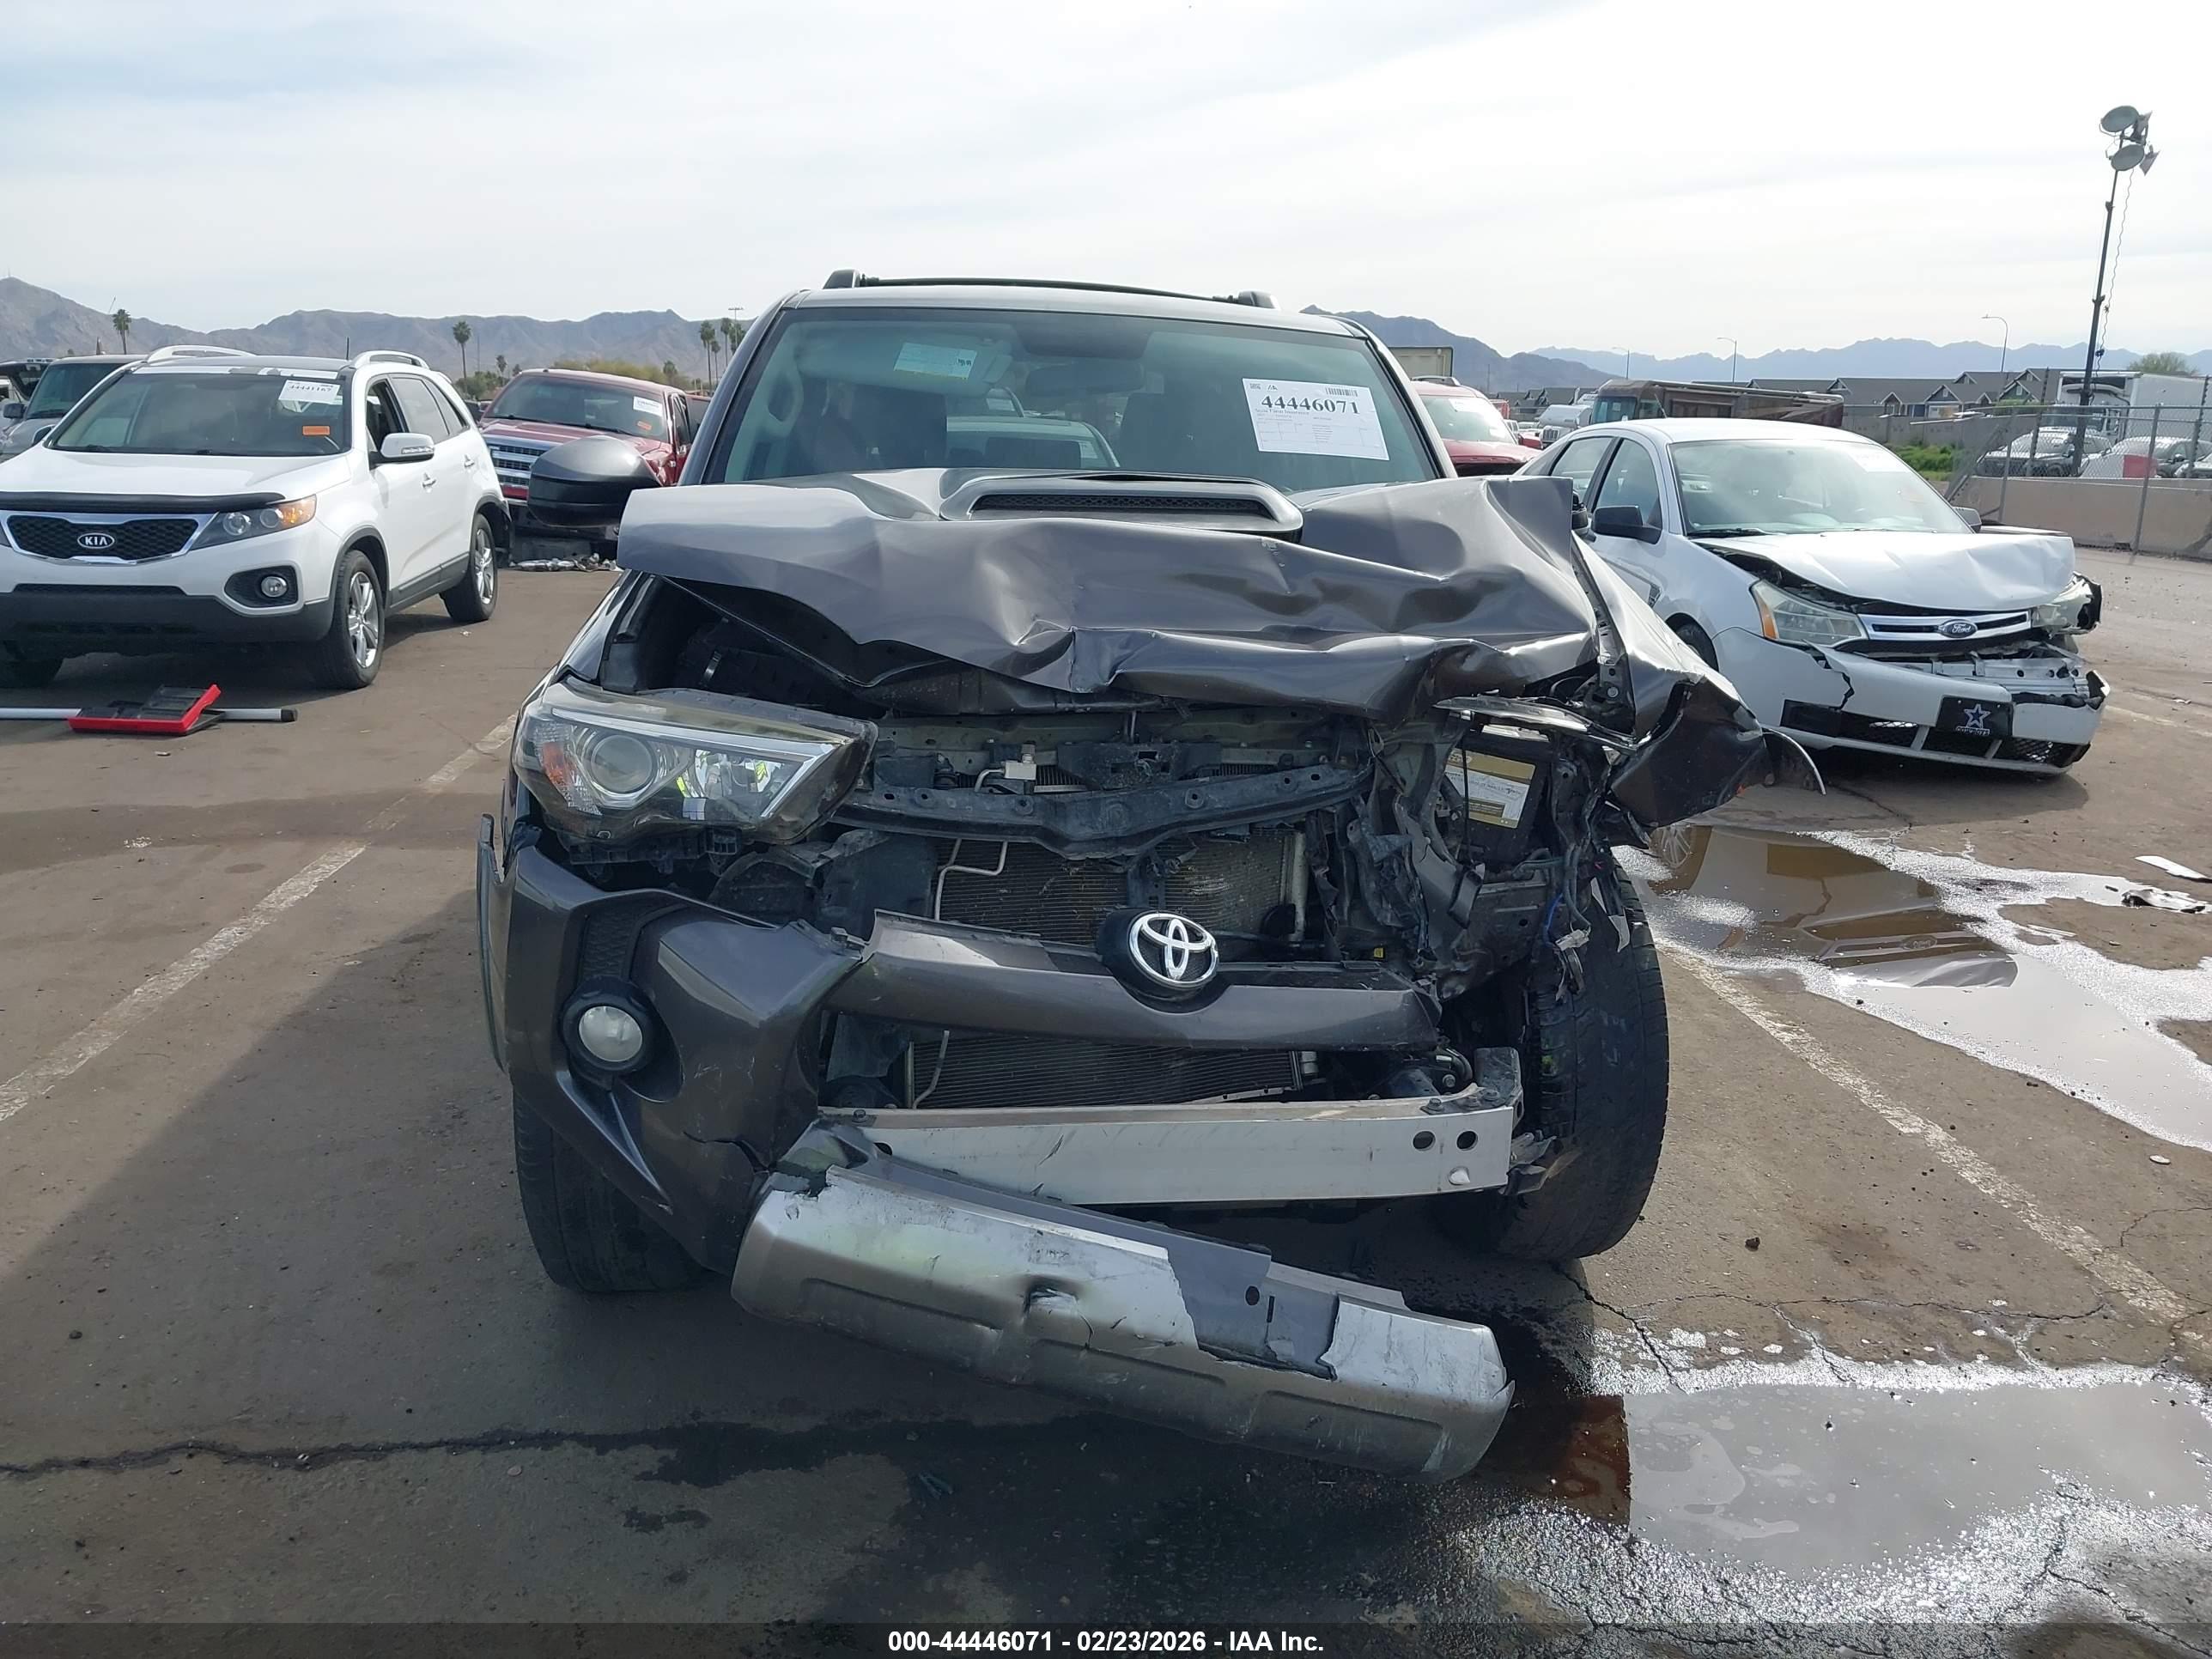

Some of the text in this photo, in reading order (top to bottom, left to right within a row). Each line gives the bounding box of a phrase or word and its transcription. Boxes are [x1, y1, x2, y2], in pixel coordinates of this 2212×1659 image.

[1261, 395, 1360, 415] 44446071
[84, 536, 108, 546] KIA
[1951, 623, 1972, 634] Ford
